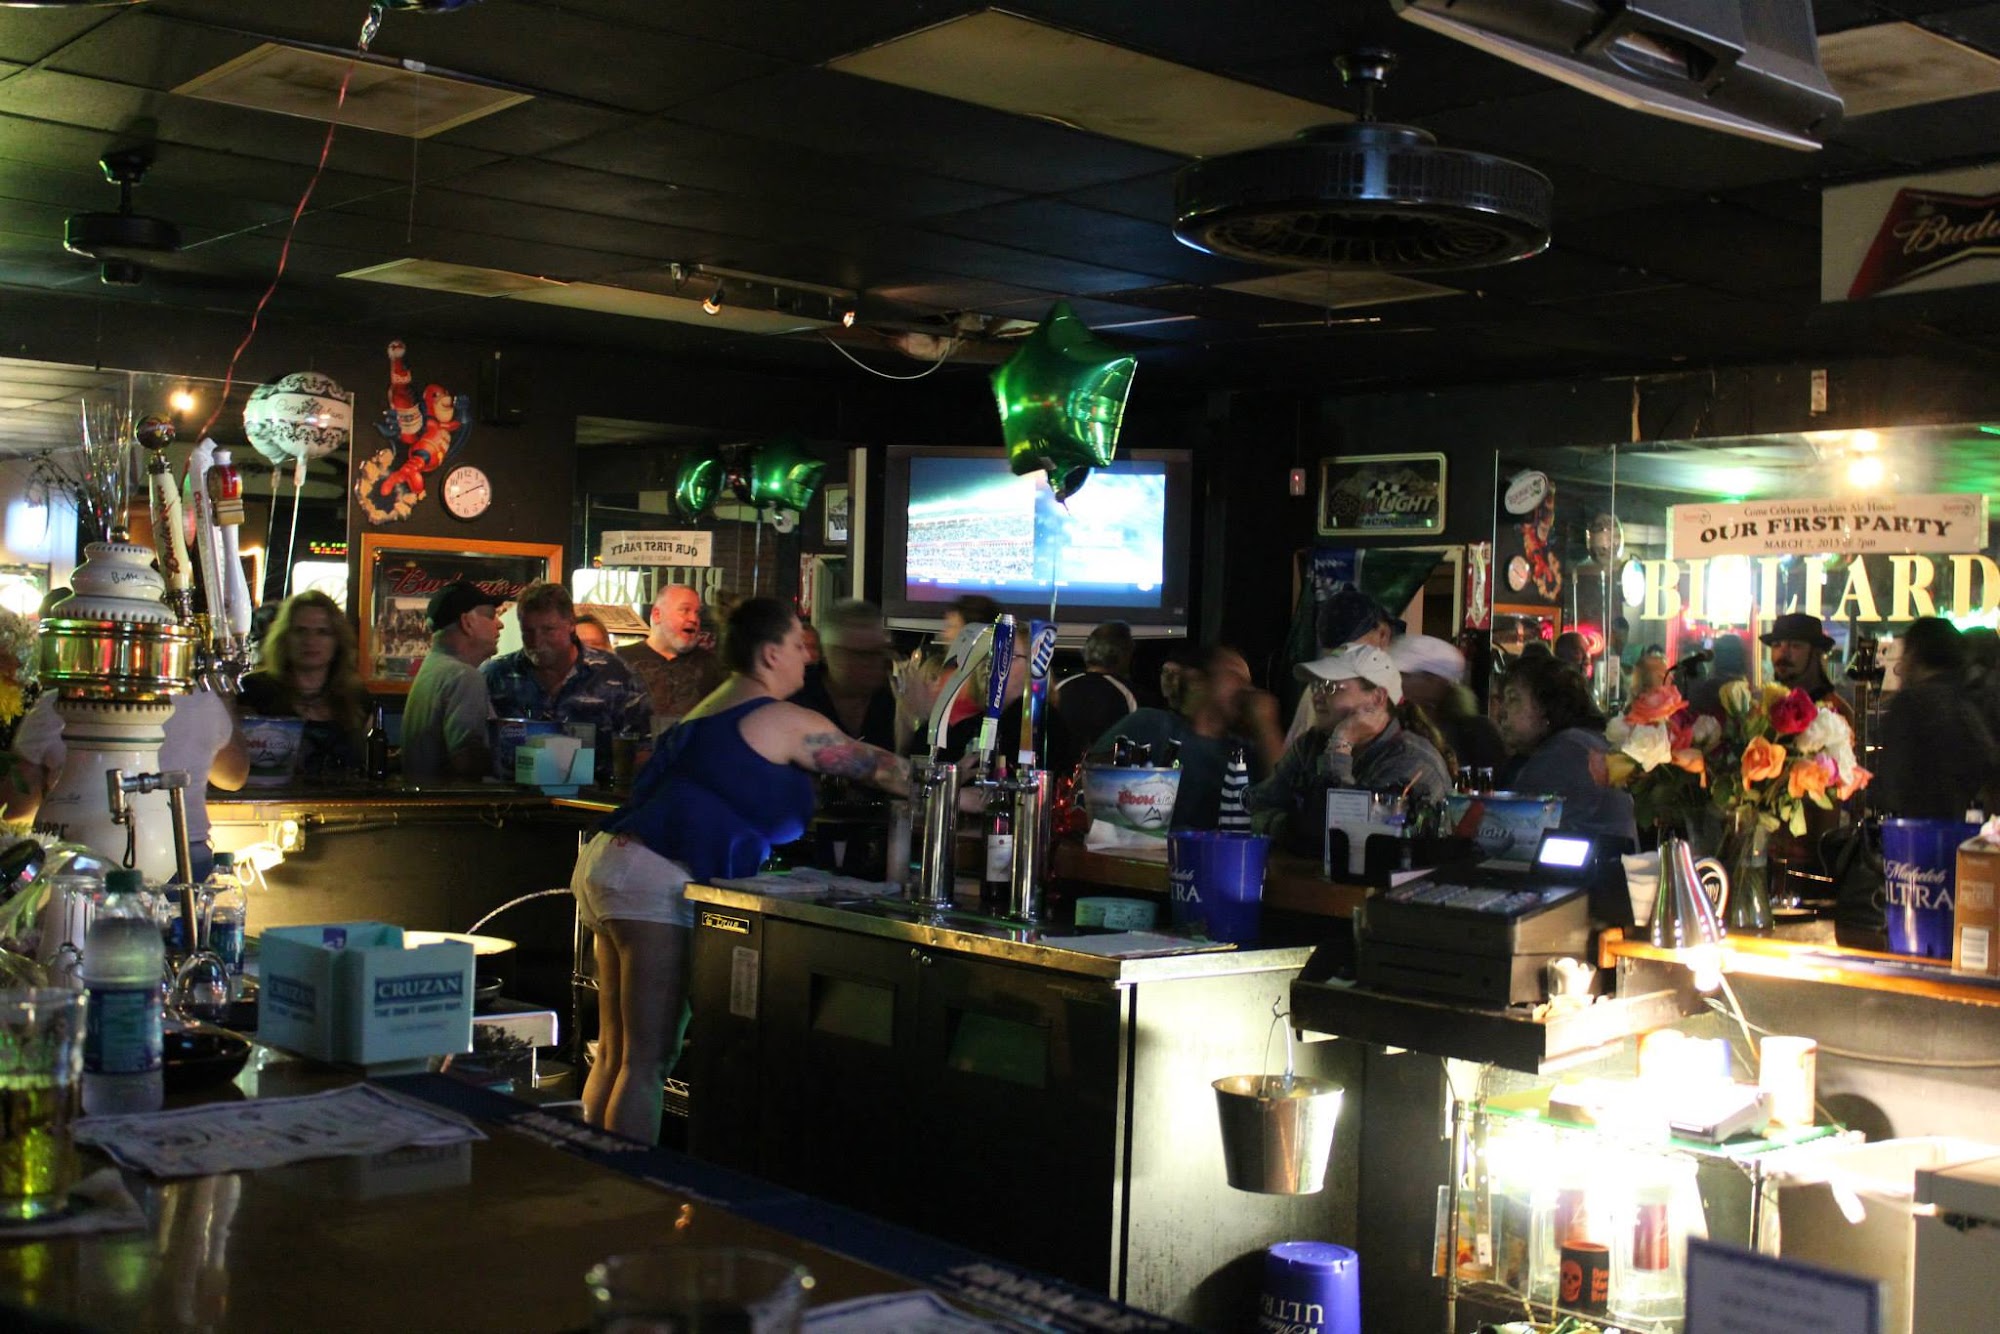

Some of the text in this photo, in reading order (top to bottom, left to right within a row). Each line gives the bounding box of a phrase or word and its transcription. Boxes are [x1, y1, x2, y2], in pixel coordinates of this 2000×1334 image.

[1378, 497, 1434, 513] LIGHT
[1744, 506, 1767, 518] Come
[1770, 504, 1809, 516] Celebrate
[1700, 514, 1952, 543] OUR FIRST PARTY
[1763, 539, 1804, 550] MARCH
[993, 681, 1004, 709] BUD
[1118, 786, 1156, 806] Coors
[377, 976, 462, 999] CRUZAN
